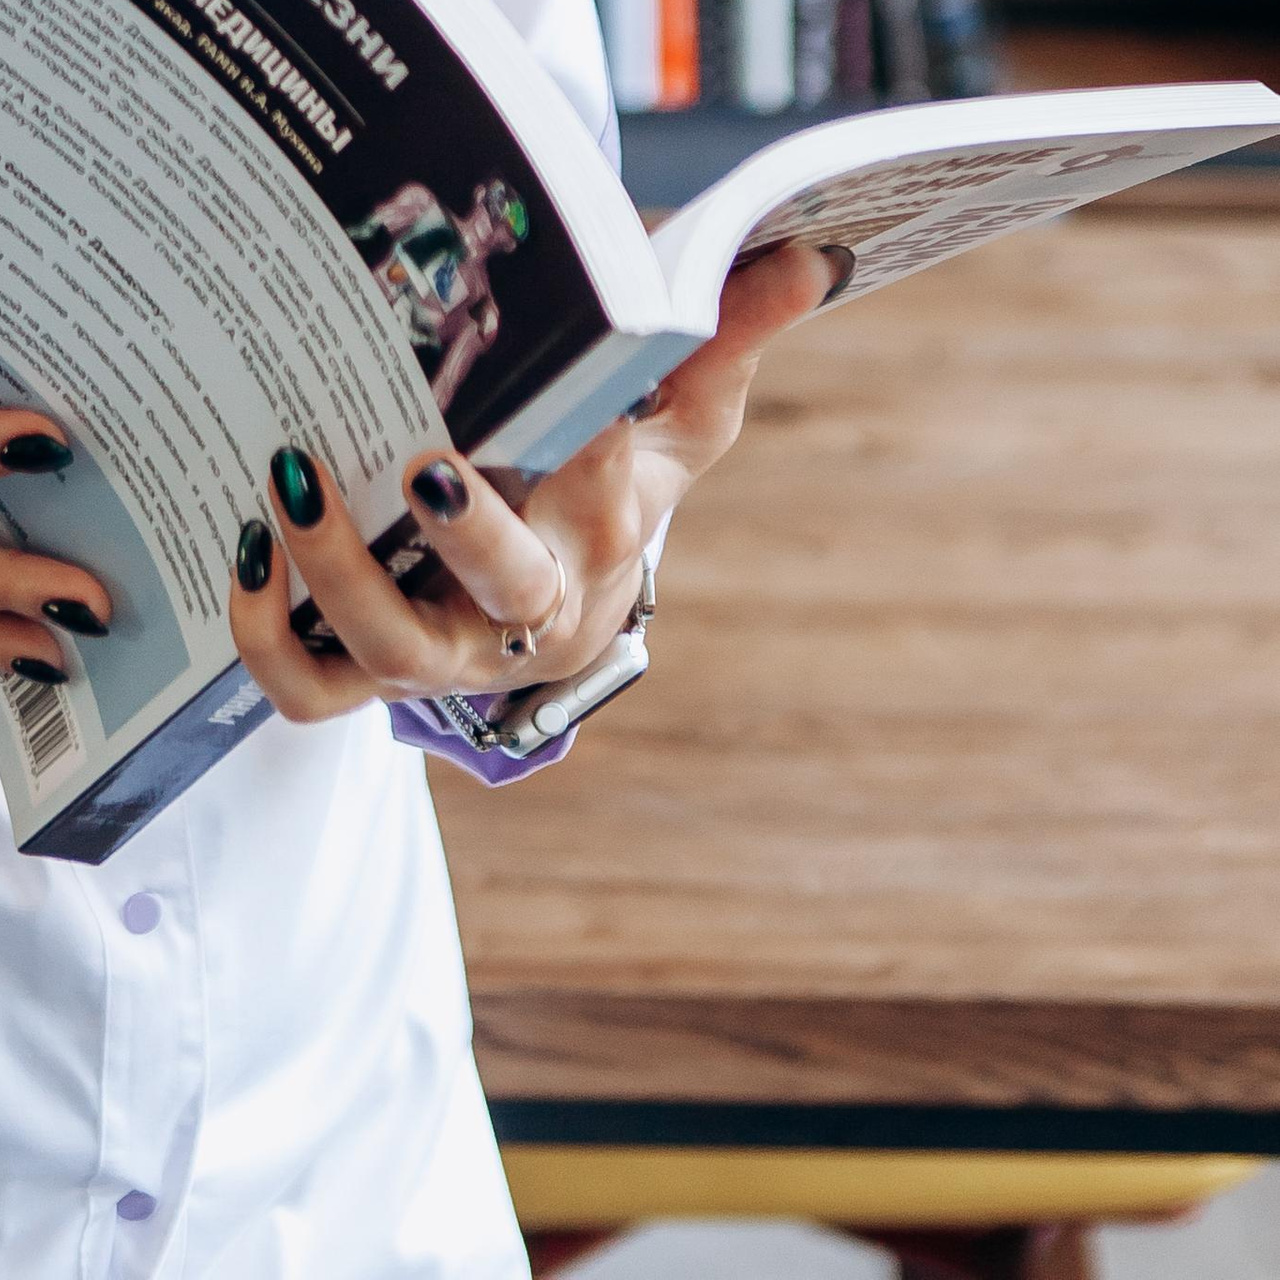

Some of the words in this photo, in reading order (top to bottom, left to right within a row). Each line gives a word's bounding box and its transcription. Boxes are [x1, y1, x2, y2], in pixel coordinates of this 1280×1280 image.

[193, 31, 244, 81] РАМН
[237, 73, 274, 114] Н.А.
[266, 107, 326, 179] Мухина
